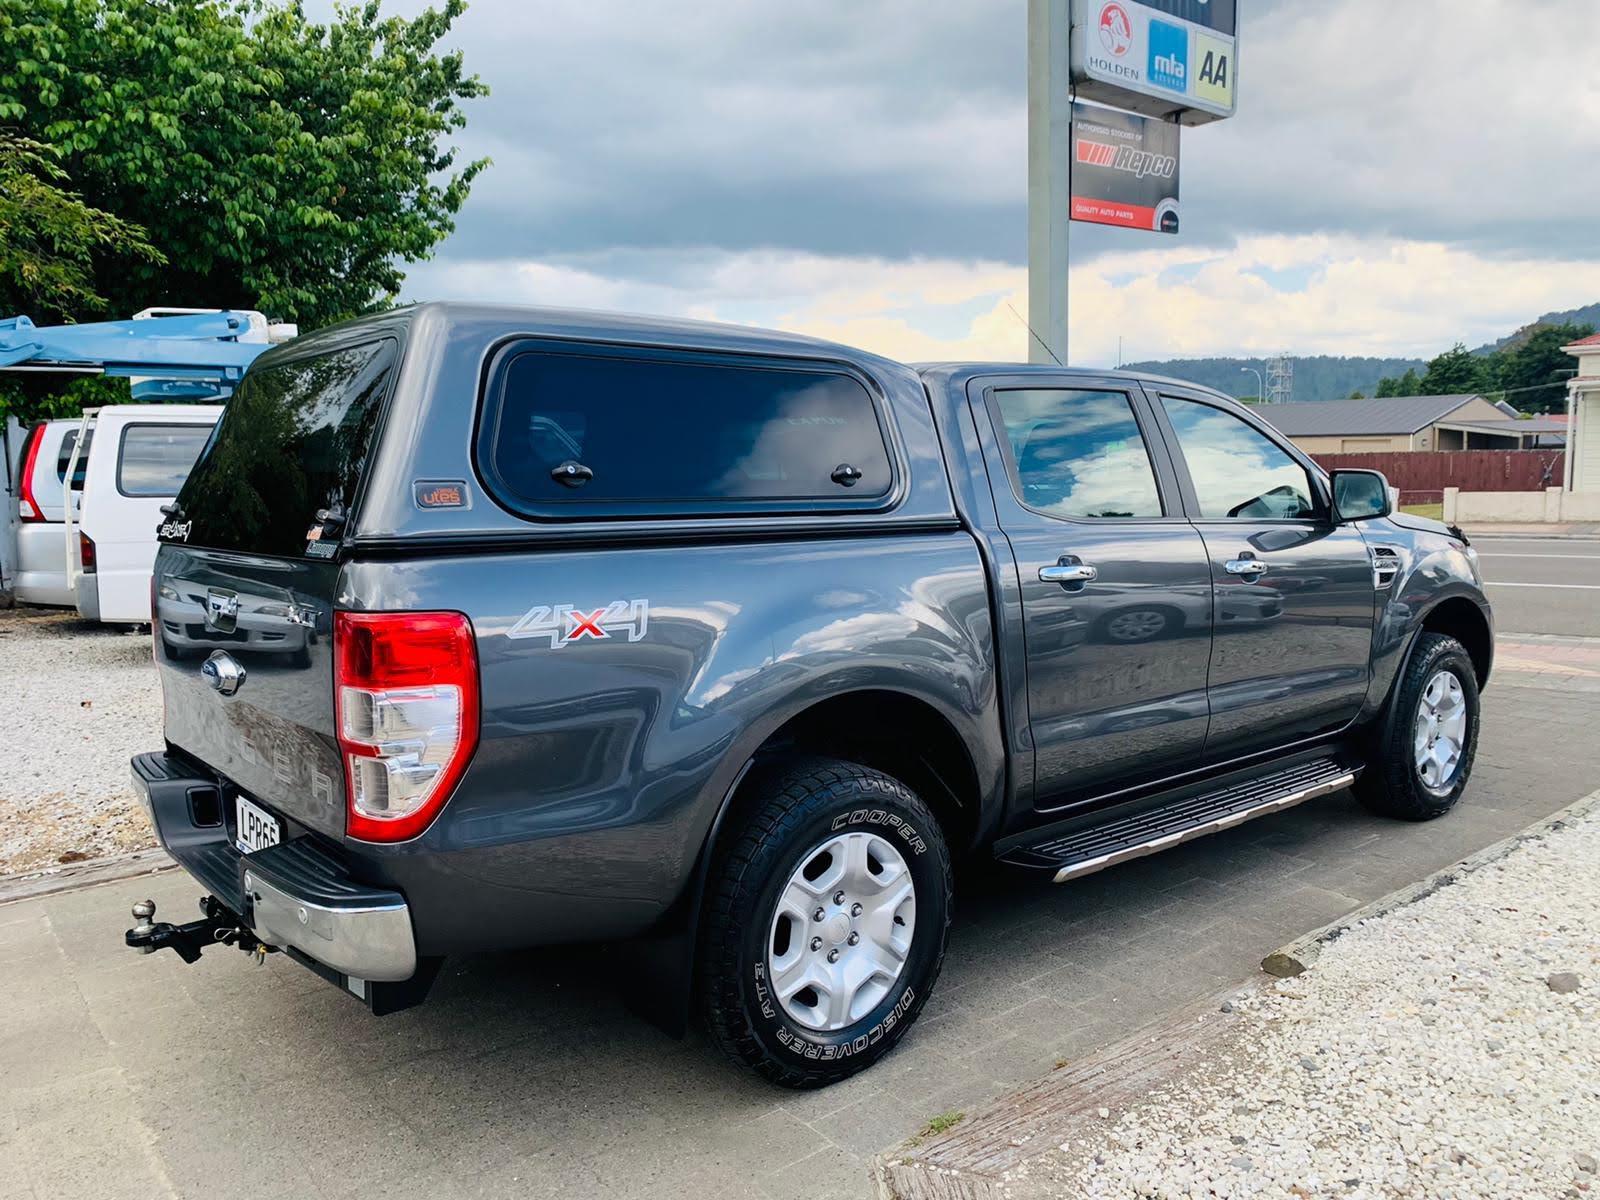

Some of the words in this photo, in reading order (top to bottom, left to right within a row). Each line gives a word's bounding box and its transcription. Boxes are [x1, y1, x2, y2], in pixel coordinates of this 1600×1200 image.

[1089, 57, 1139, 80] HOLDEN
[1199, 51, 1227, 88] AA
[1114, 144, 1177, 179] Repco
[1075, 204, 1099, 215] QUALITY
[1100, 208, 1116, 217] AUTO
[1116, 211, 1134, 220] PARTS
[831, 809, 928, 855] COOPER
[776, 986, 915, 1060] DISCOVERER
